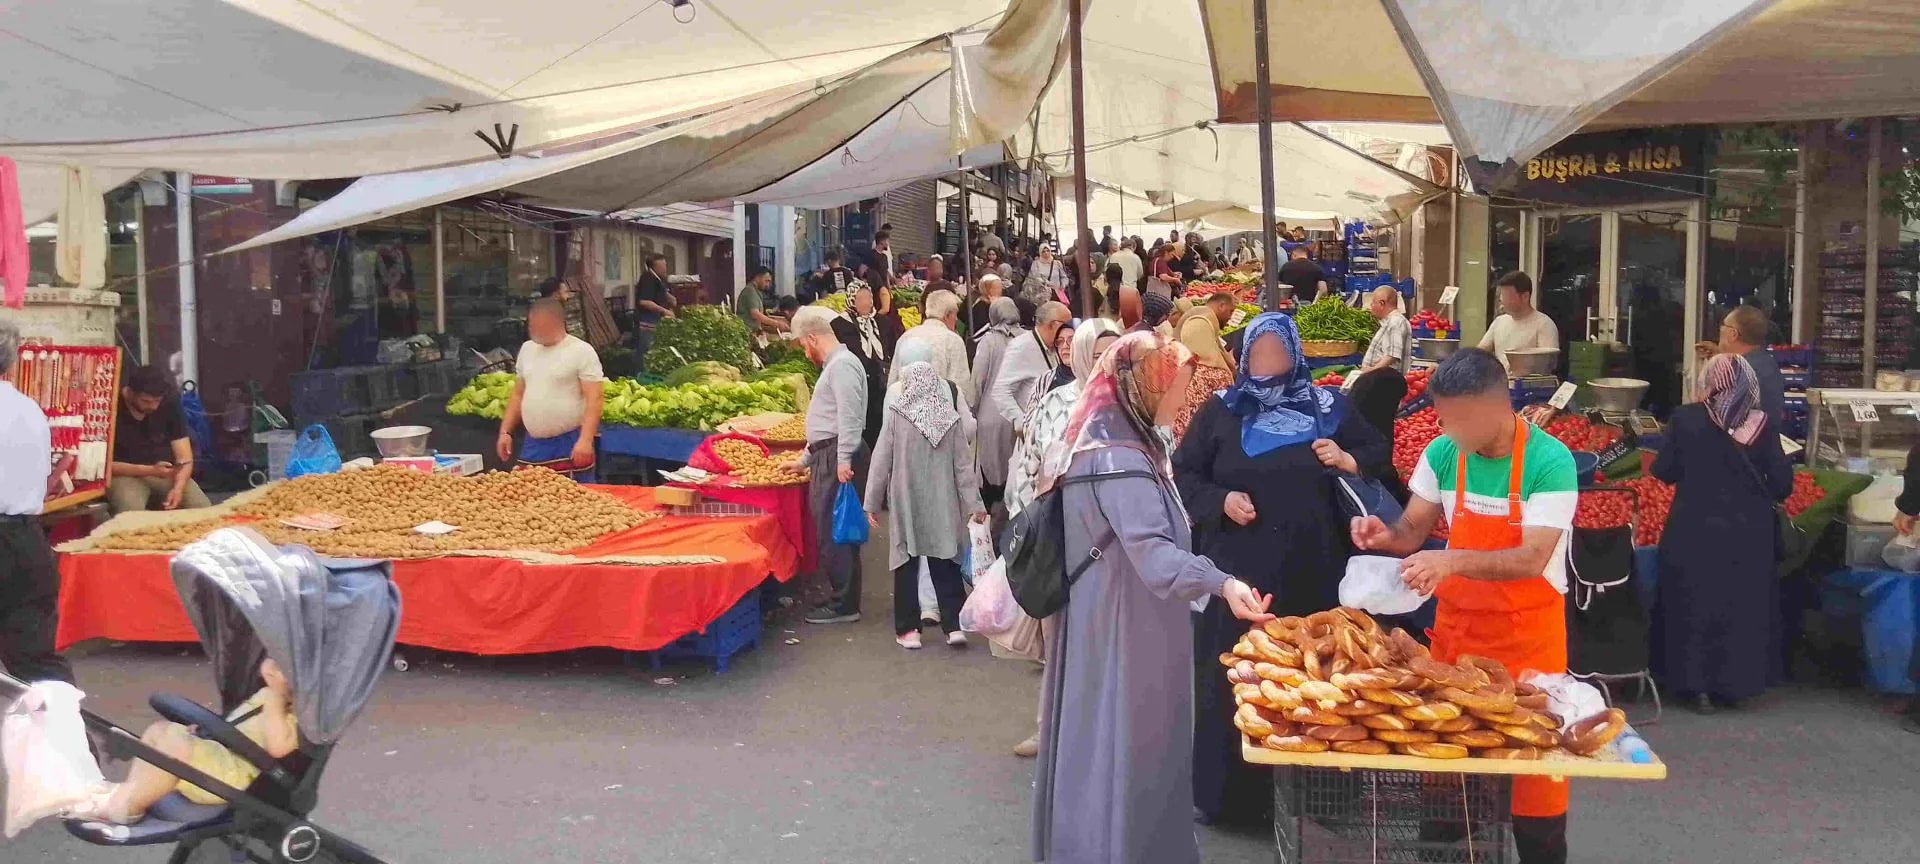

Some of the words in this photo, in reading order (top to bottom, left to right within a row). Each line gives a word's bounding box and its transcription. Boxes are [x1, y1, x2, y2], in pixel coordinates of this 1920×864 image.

[1527, 152, 1597, 183] BÜŞRA
[1603, 152, 1621, 174] &
[1628, 142, 1682, 172] NİSA
